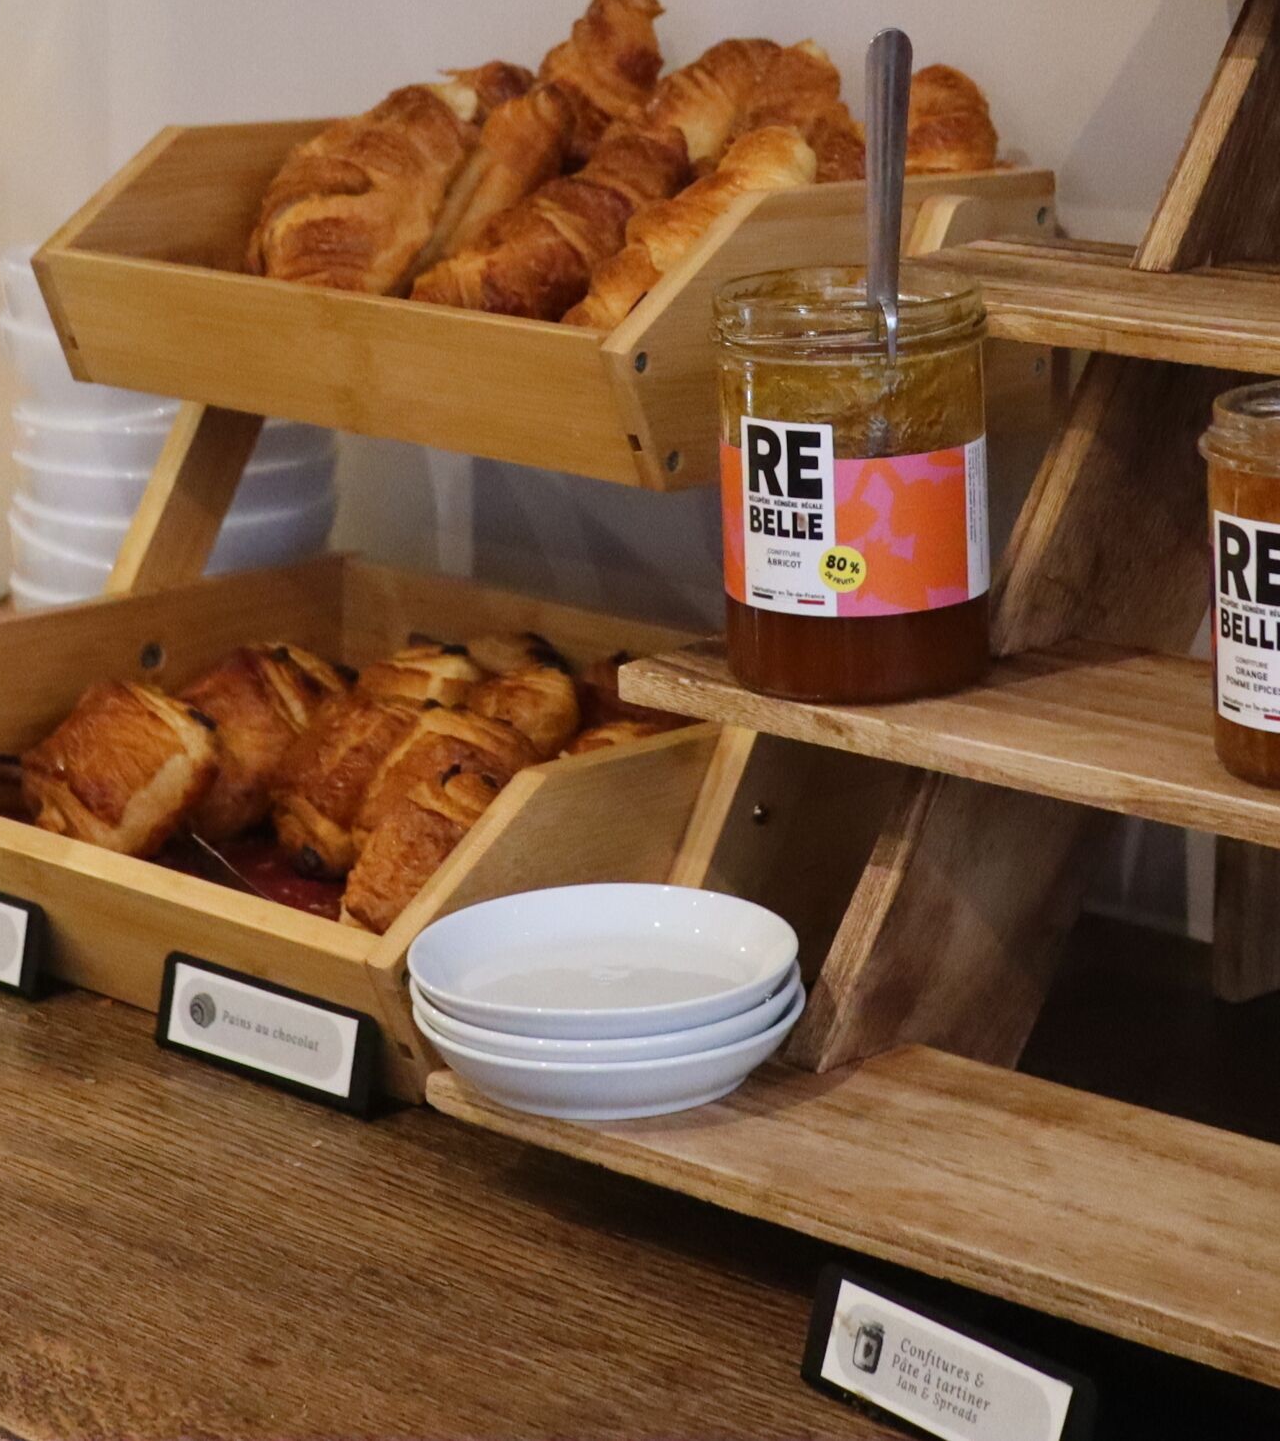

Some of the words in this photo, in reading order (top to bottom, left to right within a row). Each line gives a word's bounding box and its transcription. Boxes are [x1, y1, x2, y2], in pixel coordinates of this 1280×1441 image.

[747, 424, 823, 500] RE
[749, 505, 823, 540] BELLE
[767, 548, 800, 557] CONFITURE
[767, 557, 802, 568] ABRICOT
[1226, 675, 1250, 690] POMME
[1235, 666, 1268, 681] ORANGE
[223, 1009, 252, 1030] Pains
[255, 1023, 269, 1036] au
[272, 1026, 319, 1052] chocolat
[892, 1353, 920, 1379] Pâte
[923, 1368, 932, 1385] à
[936, 1377, 991, 1411] tartiner
[900, 1337, 970, 1383] Confitures
[974, 1372, 984, 1388] &
[896, 1375, 918, 1395] Jam
[920, 1387, 930, 1400] &
[933, 1392, 978, 1424] Spreads
